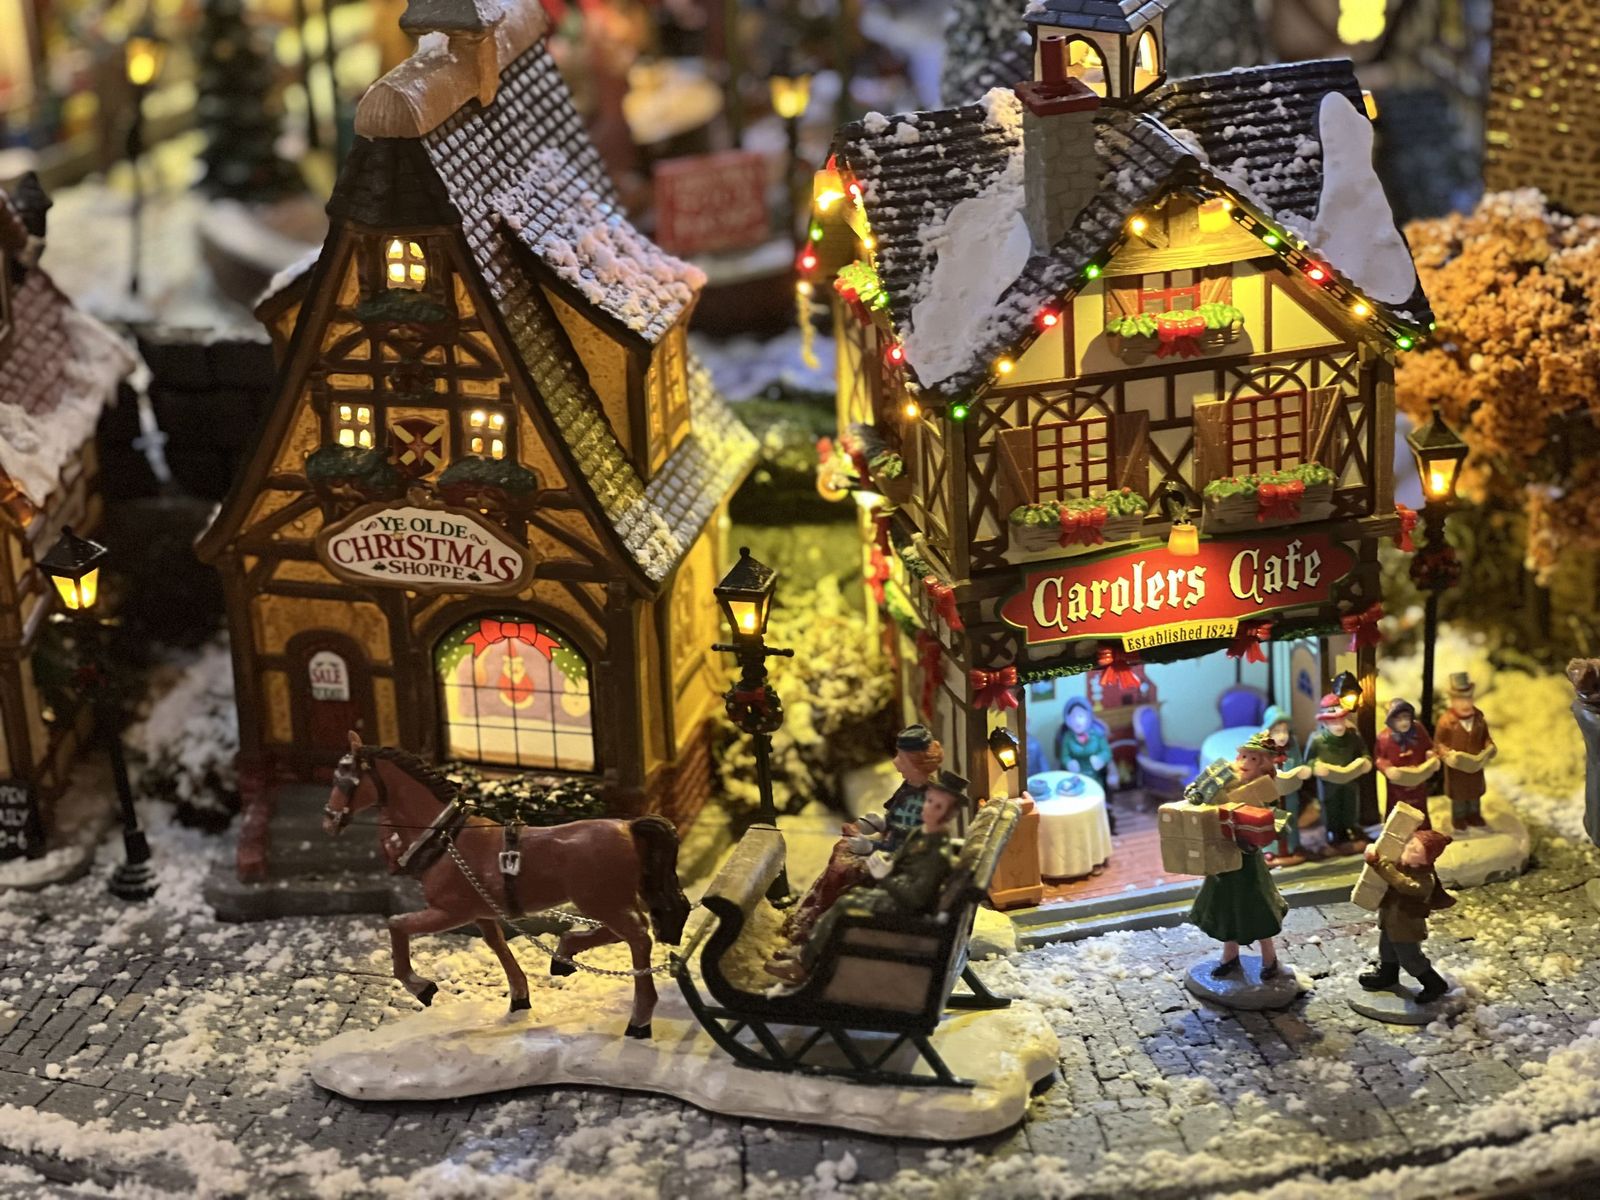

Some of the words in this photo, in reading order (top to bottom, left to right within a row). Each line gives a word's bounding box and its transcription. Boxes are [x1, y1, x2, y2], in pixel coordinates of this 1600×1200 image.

[377, 516, 408, 532] YE
[409, 517, 468, 538] OLDE
[332, 533, 517, 582] CHRISTMAS
[388, 560, 465, 581] SHOPPE
[1031, 560, 1207, 633] Carolers
[1228, 539, 1322, 604] Cafe
[1127, 625, 1203, 651] Established
[1206, 623, 1235, 639] 1824
[312, 668, 342, 684] SALE
